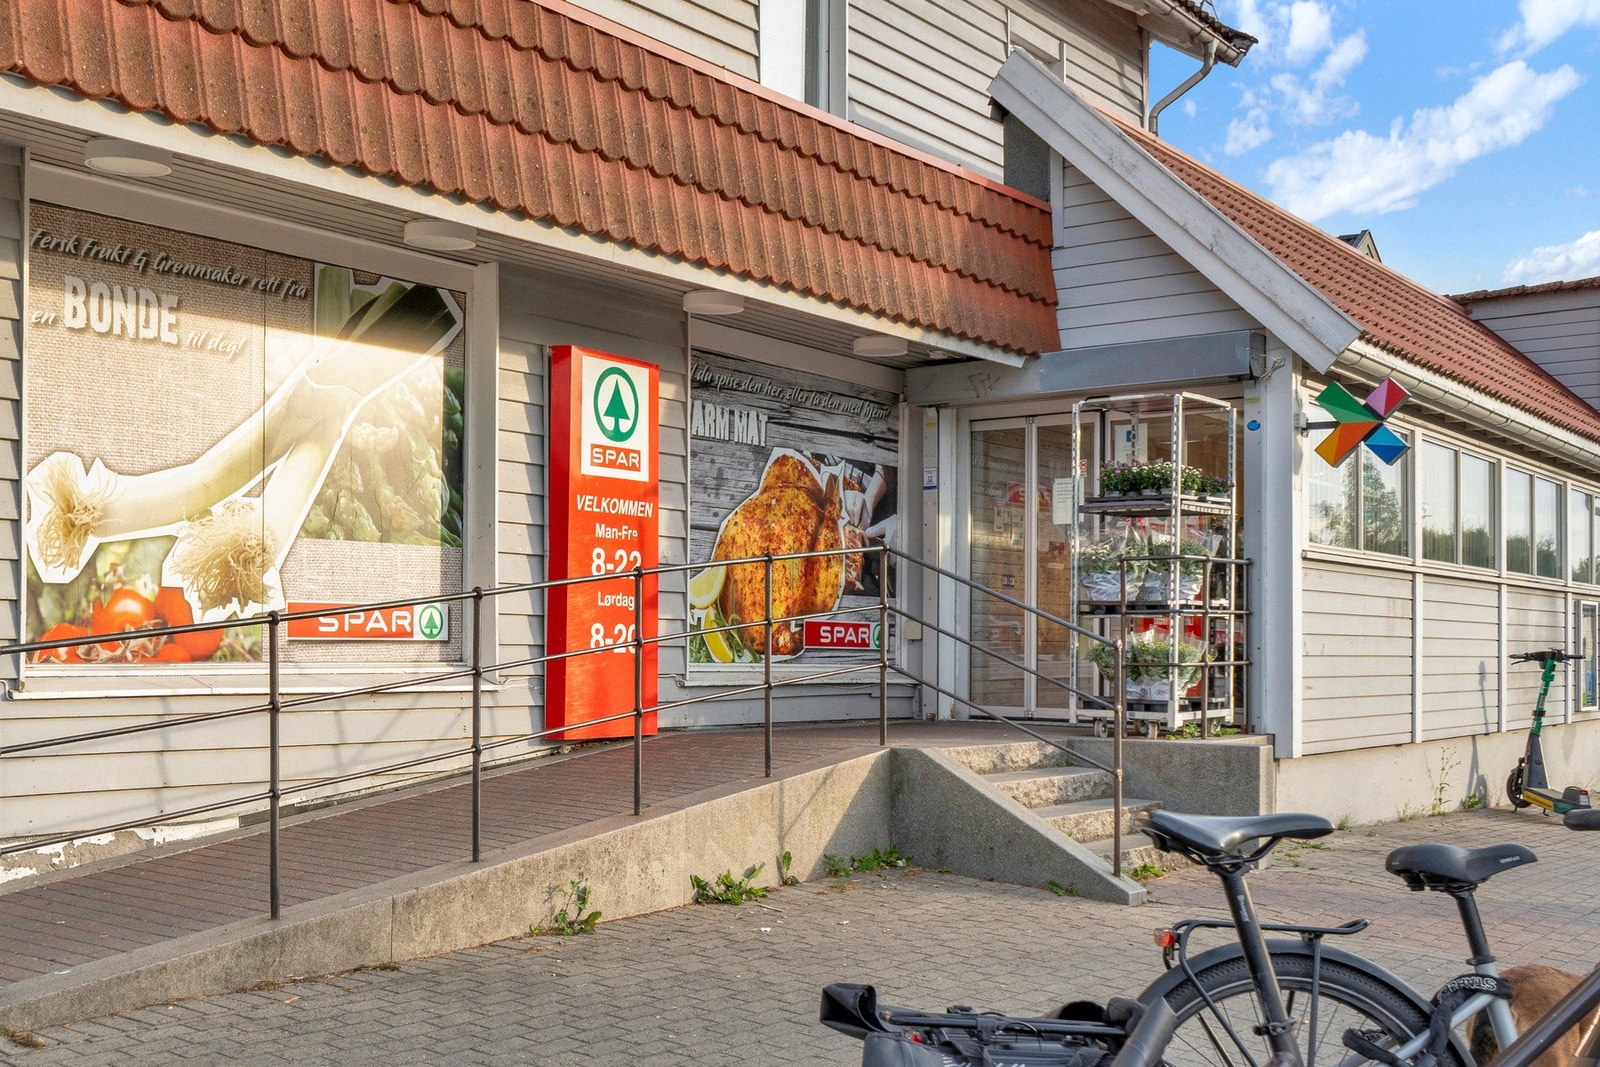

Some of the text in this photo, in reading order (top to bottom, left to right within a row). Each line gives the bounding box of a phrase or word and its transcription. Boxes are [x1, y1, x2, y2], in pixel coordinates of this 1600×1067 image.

[30, 228, 78, 254] Fersk
[81, 237, 132, 264] Frukt
[251, 275, 281, 292] rett
[280, 278, 307, 299] fra
[31, 274, 246, 359] en BONDE til deg!
[715, 373, 740, 393] spise
[741, 375, 762, 393] den
[786, 385, 809, 402] eller
[822, 393, 839, 410] den
[840, 399, 865, 414] med
[691, 399, 769, 447] ARM MAT
[592, 447, 640, 468] SPAR
[576, 494, 654, 518] VELKOMMEN
[597, 591, 635, 611] Lørdag
[318, 610, 412, 633] SPAR
[820, 625, 869, 643] SPAR
